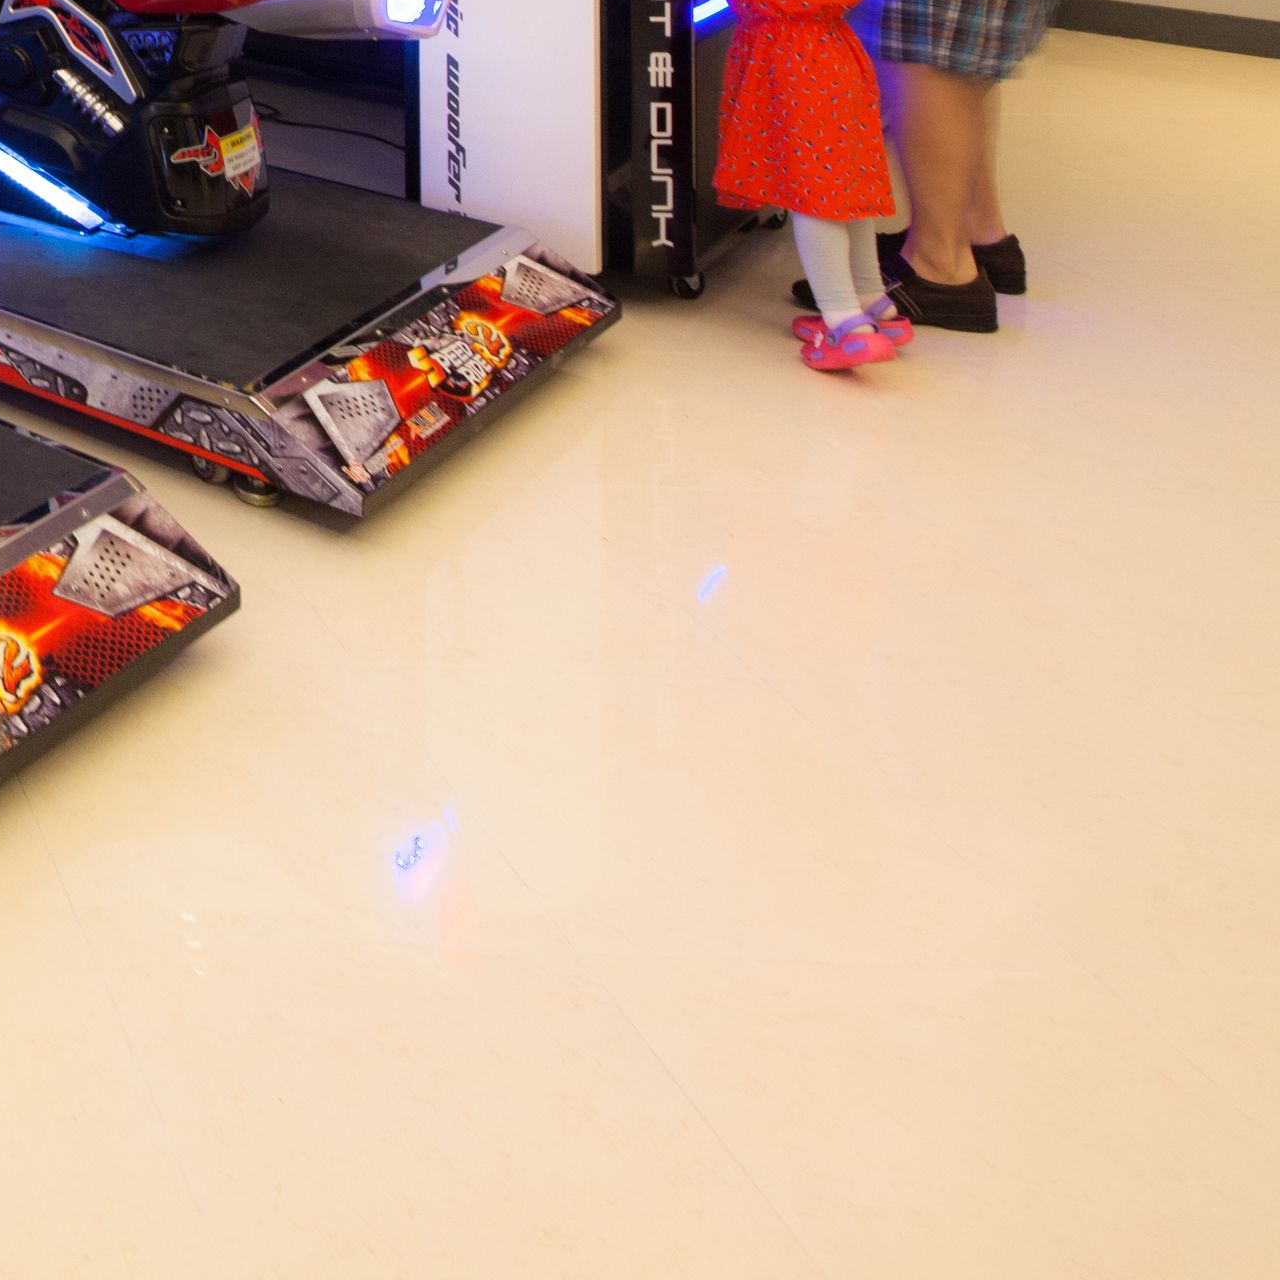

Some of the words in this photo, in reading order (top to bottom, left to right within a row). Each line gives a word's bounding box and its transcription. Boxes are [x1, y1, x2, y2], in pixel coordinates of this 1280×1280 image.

[446, 52, 467, 205] woofer
[650, 101, 675, 249] DUNK
[406, 339, 474, 389] SPEED
